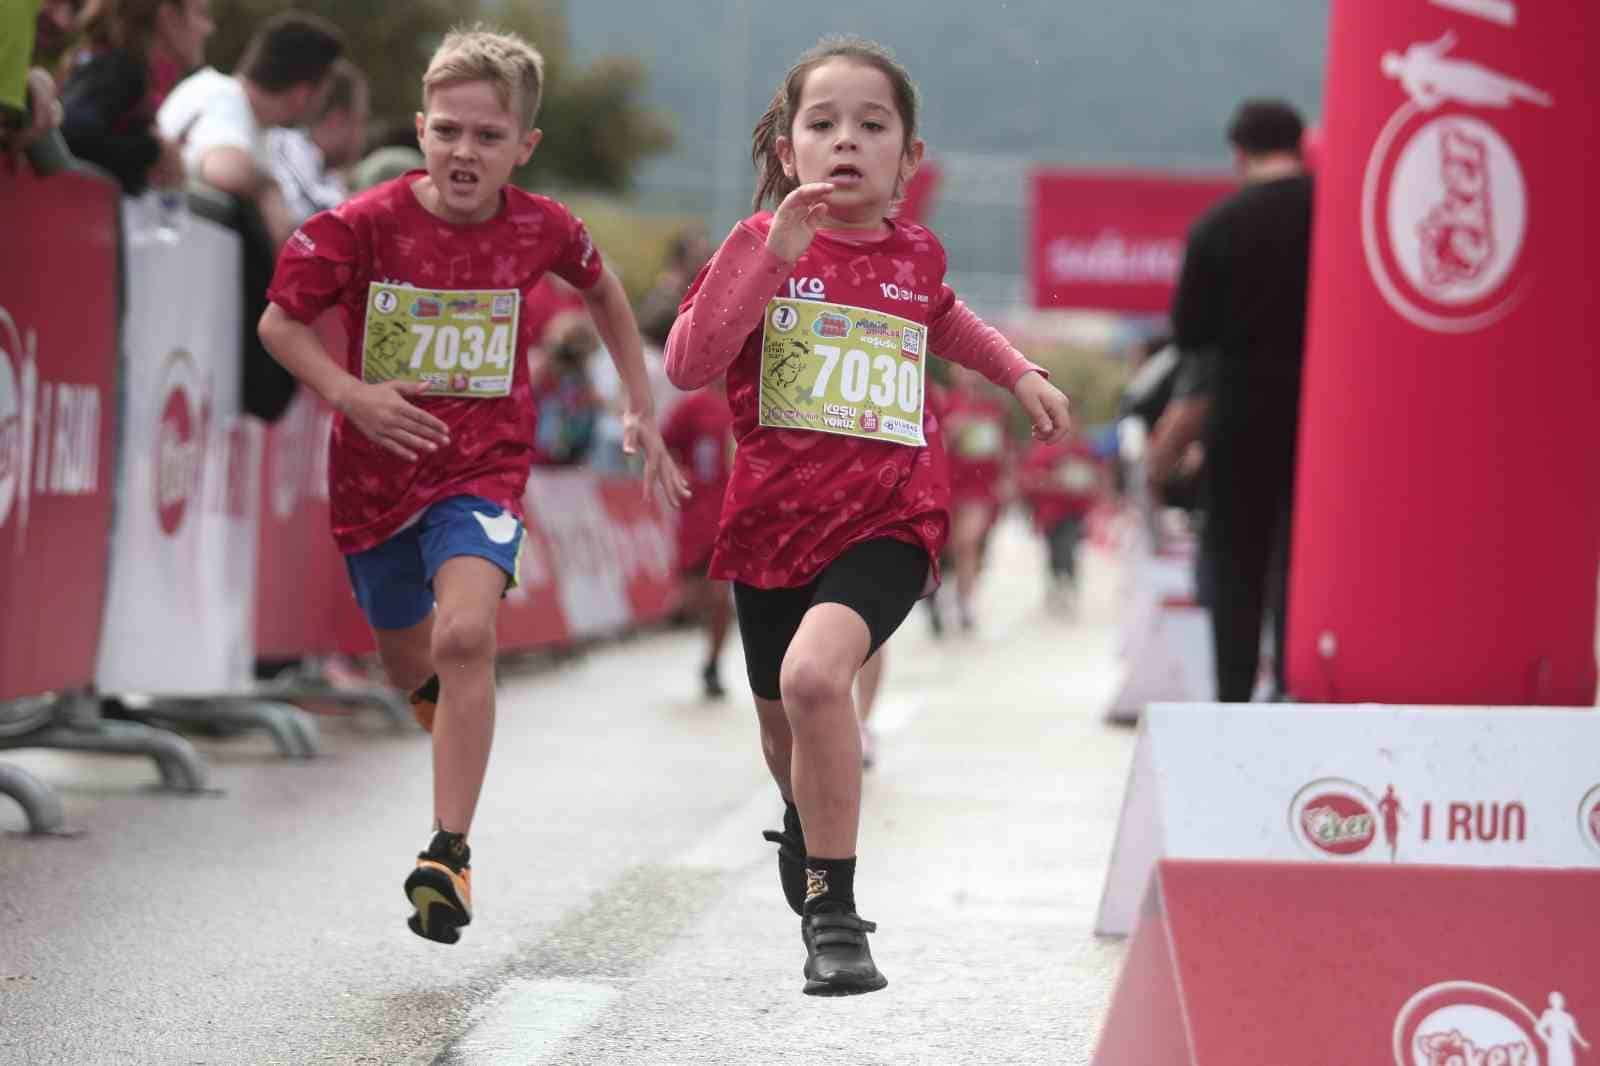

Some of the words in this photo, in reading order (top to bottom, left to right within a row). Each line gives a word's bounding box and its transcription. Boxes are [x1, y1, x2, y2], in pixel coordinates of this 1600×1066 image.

[780, 308, 789, 323] 7
[409, 324, 509, 370] 7034
[811, 344, 919, 414] 7030
[1422, 800, 1431, 841] I
[1448, 800, 1527, 841] RUN
